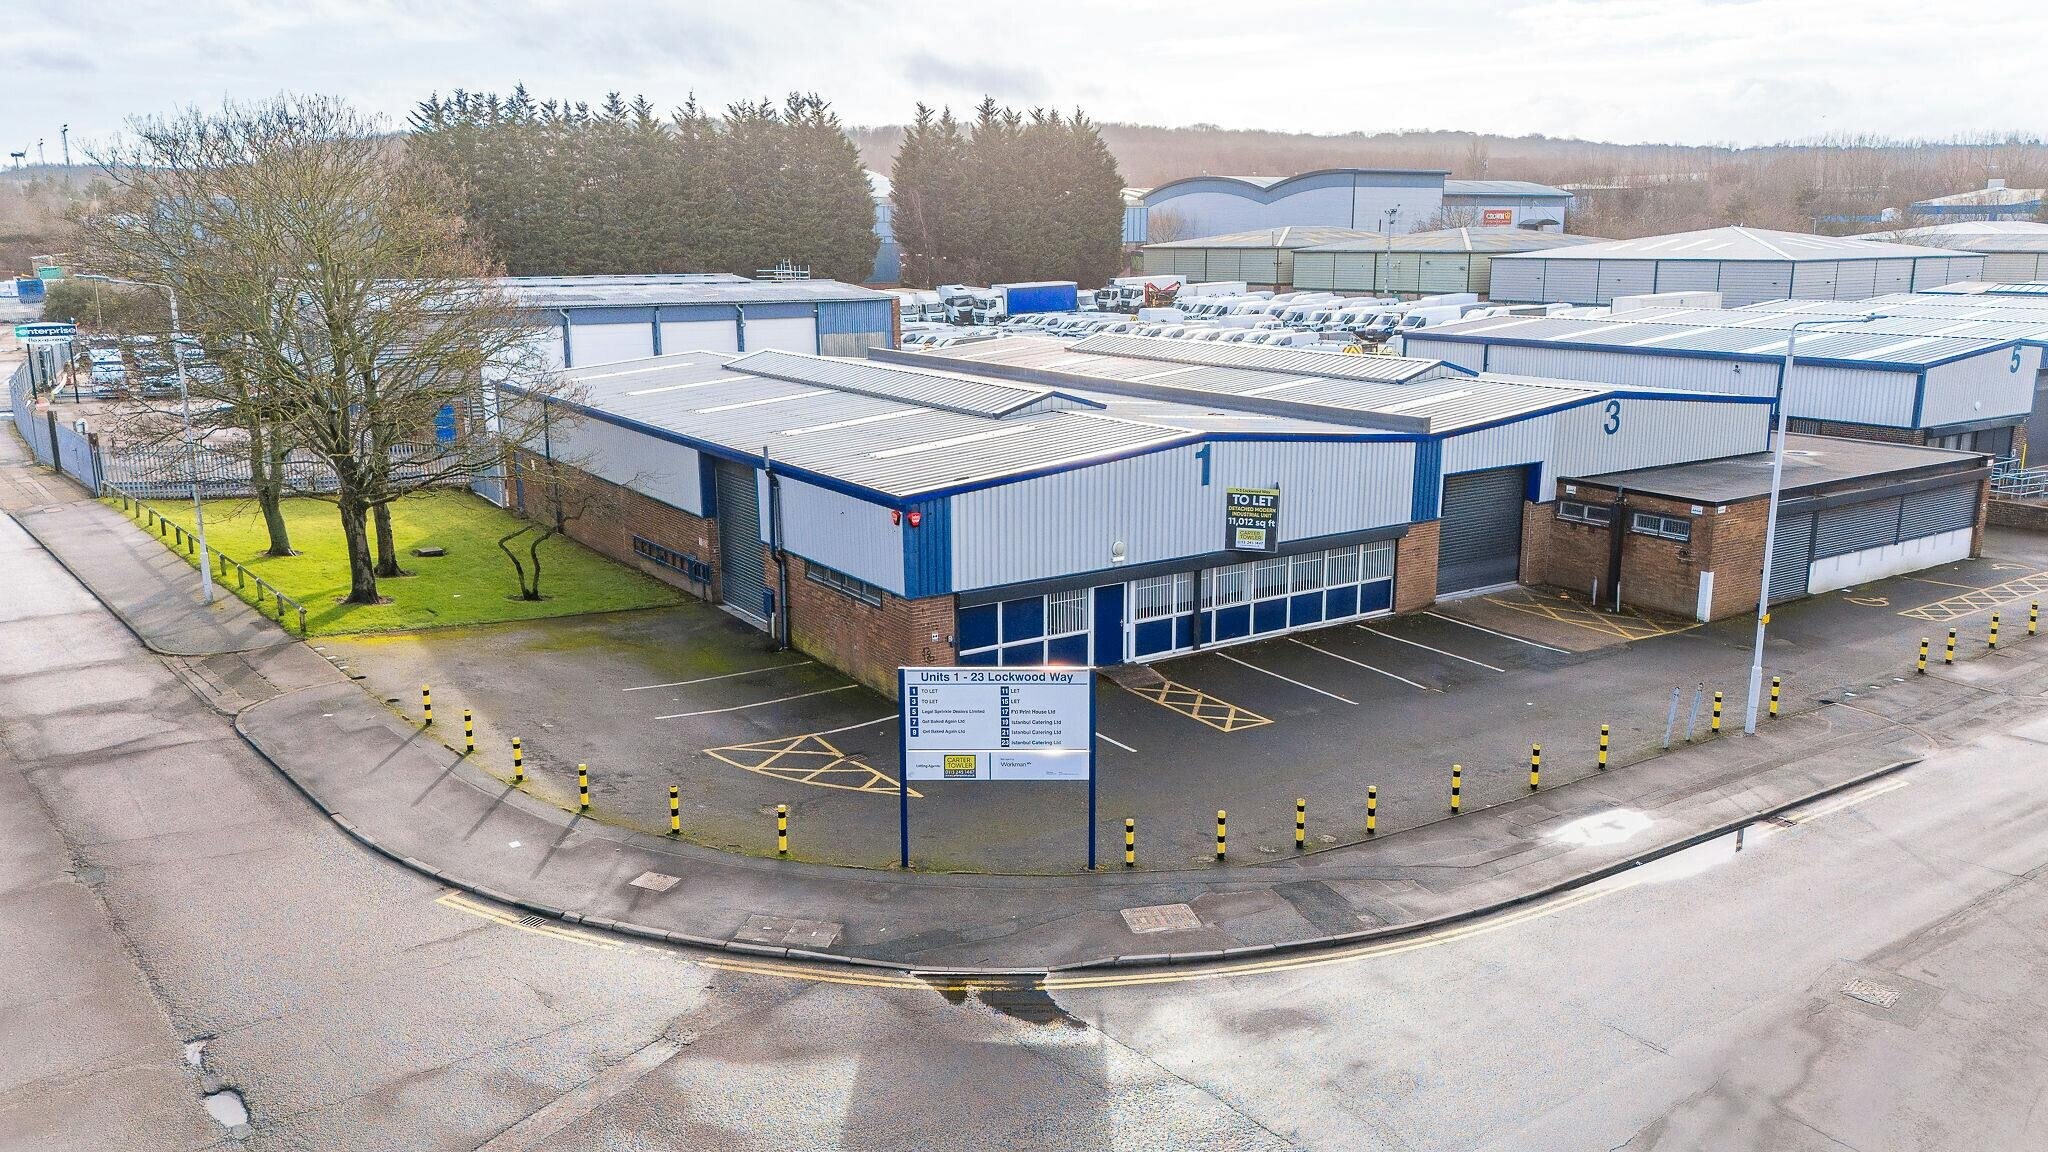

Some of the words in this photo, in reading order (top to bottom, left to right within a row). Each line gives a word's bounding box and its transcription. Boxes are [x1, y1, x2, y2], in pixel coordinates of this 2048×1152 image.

[18, 327, 76, 335] enterprise
[2010, 344, 2021, 373] 5
[1604, 400, 1620, 435] 3
[1195, 444, 1210, 486] 1
[1232, 494, 1250, 505] TO
[1252, 495, 1274, 507] LET
[1228, 517, 1254, 526] 11,012
[1255, 520, 1266, 528] sq
[1268, 519, 1276, 527] ft
[920, 672, 950, 682] Units
[954, 672, 960, 682] 1
[970, 672, 985, 682] 23
[988, 672, 1046, 682] Lockwood
[1049, 672, 1074, 684] Way
